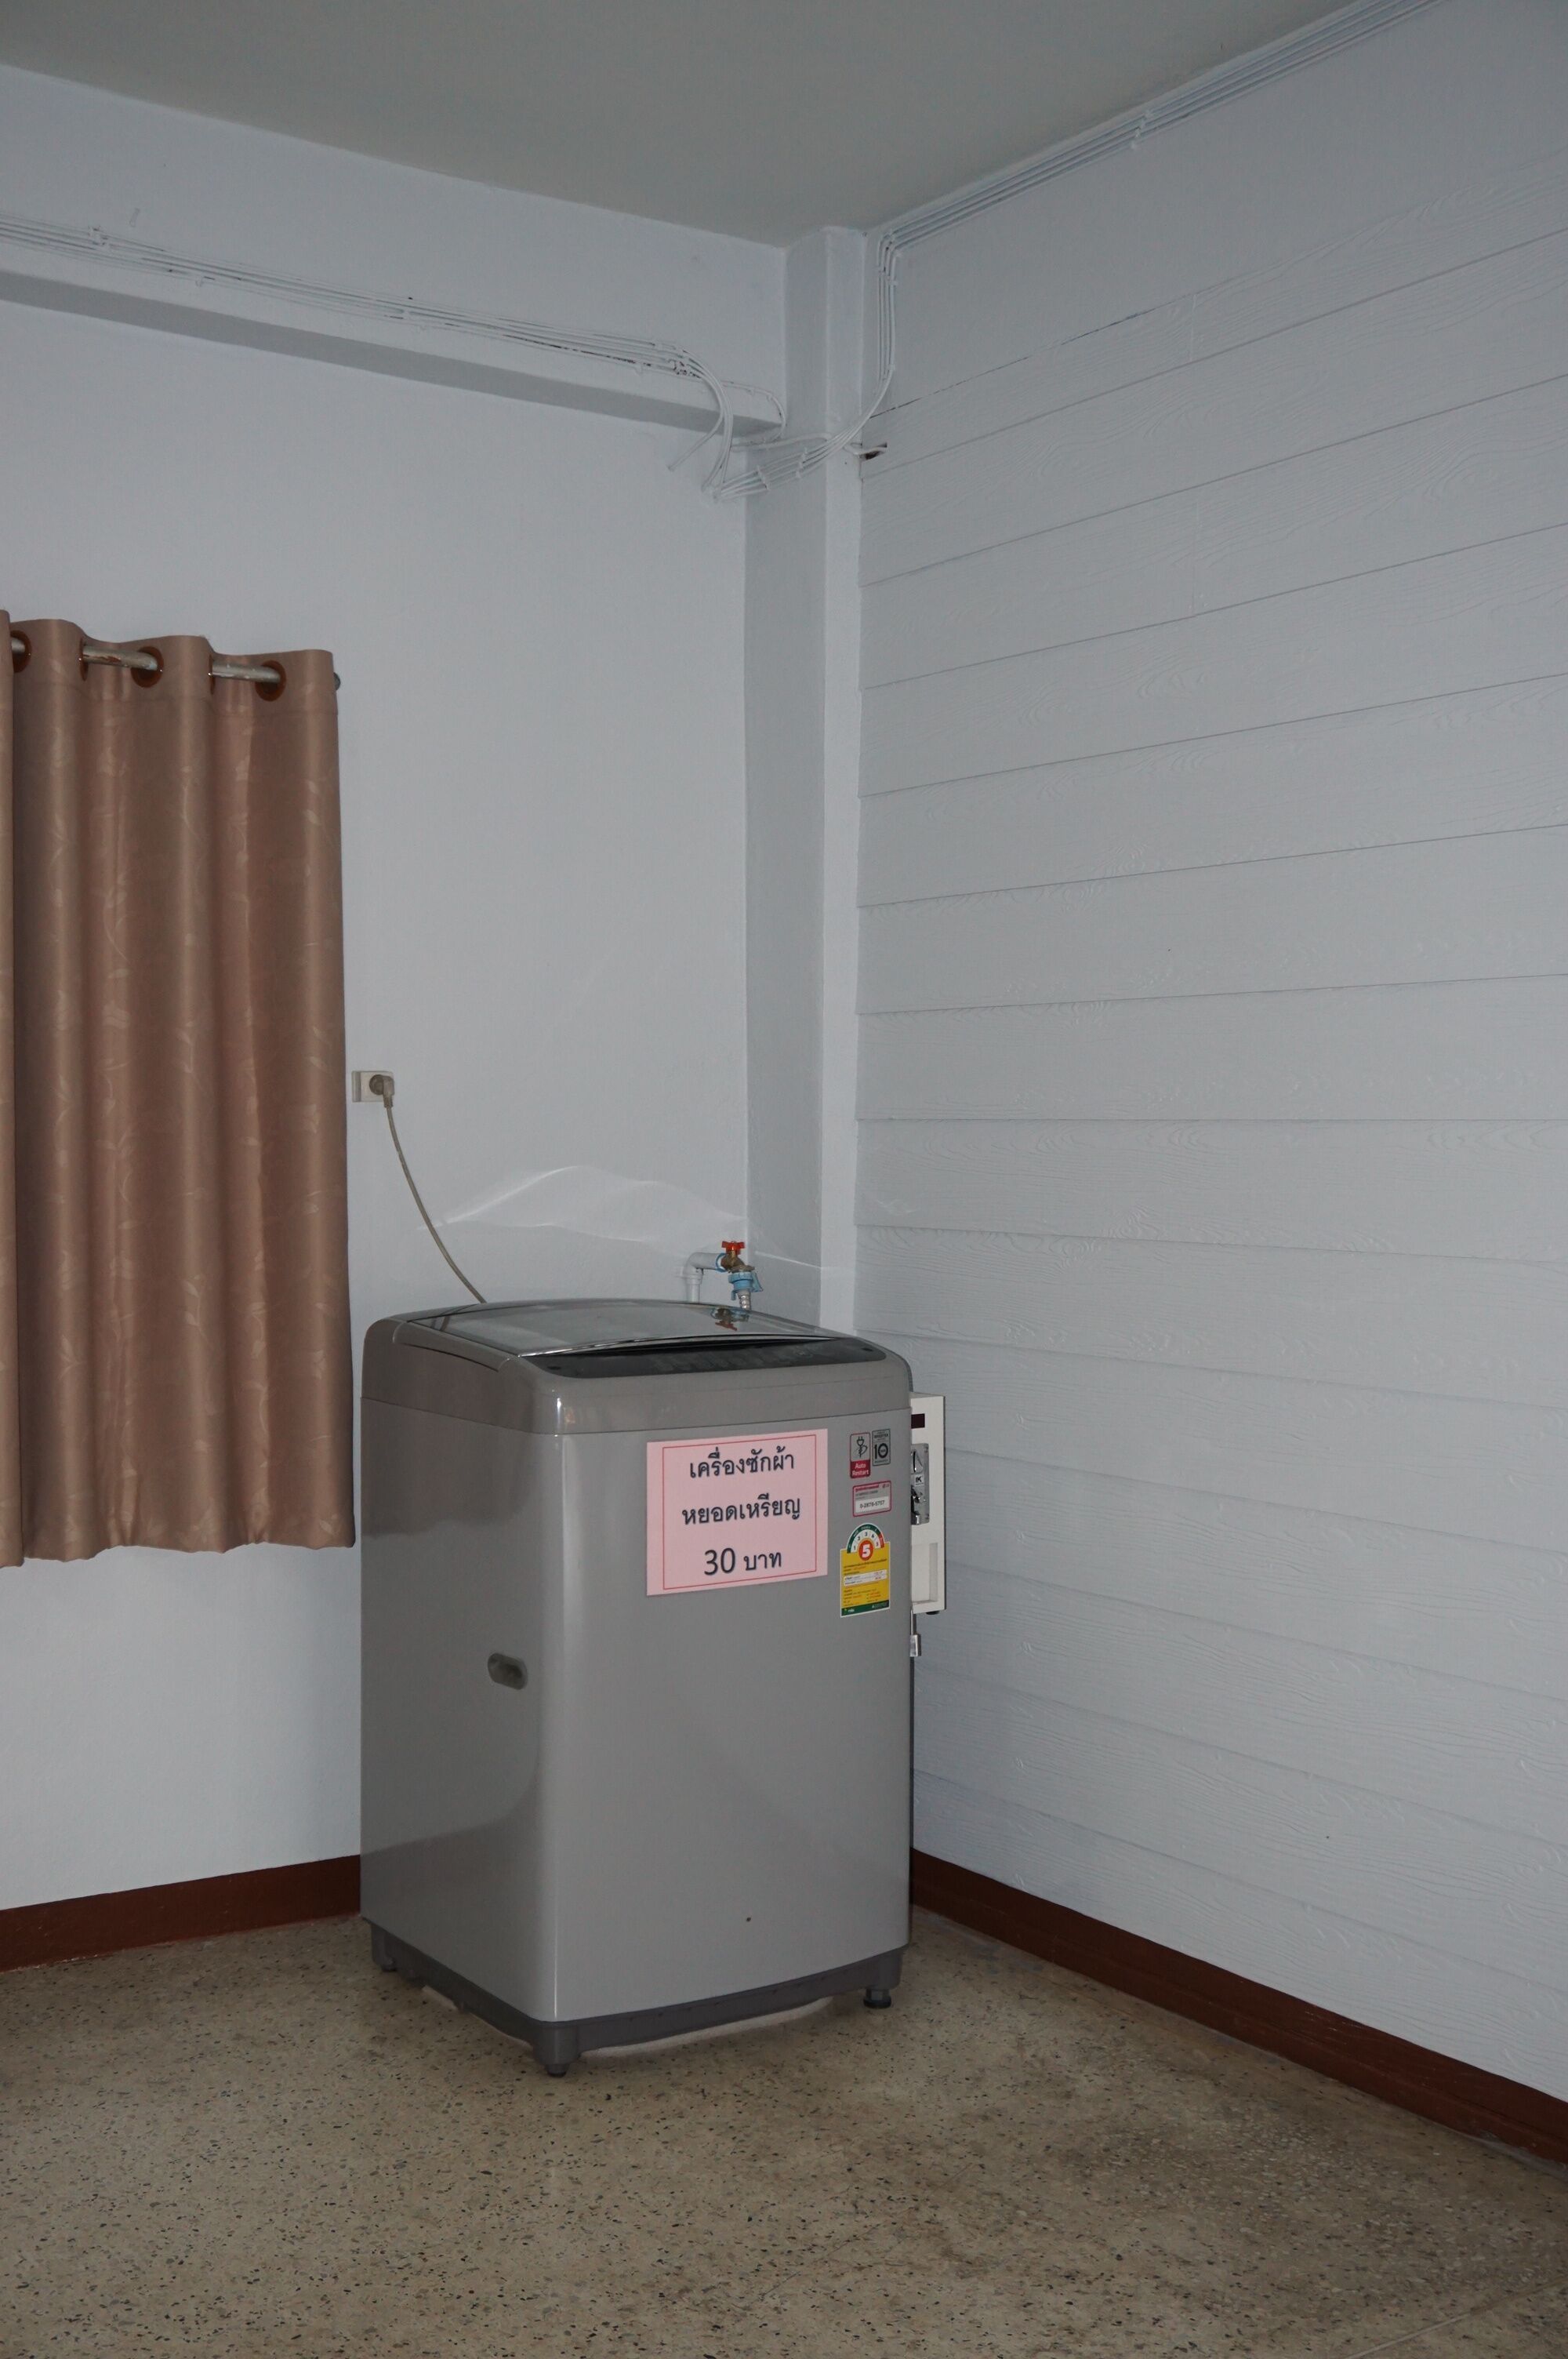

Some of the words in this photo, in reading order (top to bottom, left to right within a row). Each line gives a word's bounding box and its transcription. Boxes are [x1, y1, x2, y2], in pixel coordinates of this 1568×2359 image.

[690, 1445, 794, 1478] เครื่องซักผ้า
[681, 1492, 800, 1525] หยอดเหรียญ
[704, 1547, 736, 1576] 30
[743, 1551, 782, 1572] บาท
[862, 1543, 871, 1558] 5
